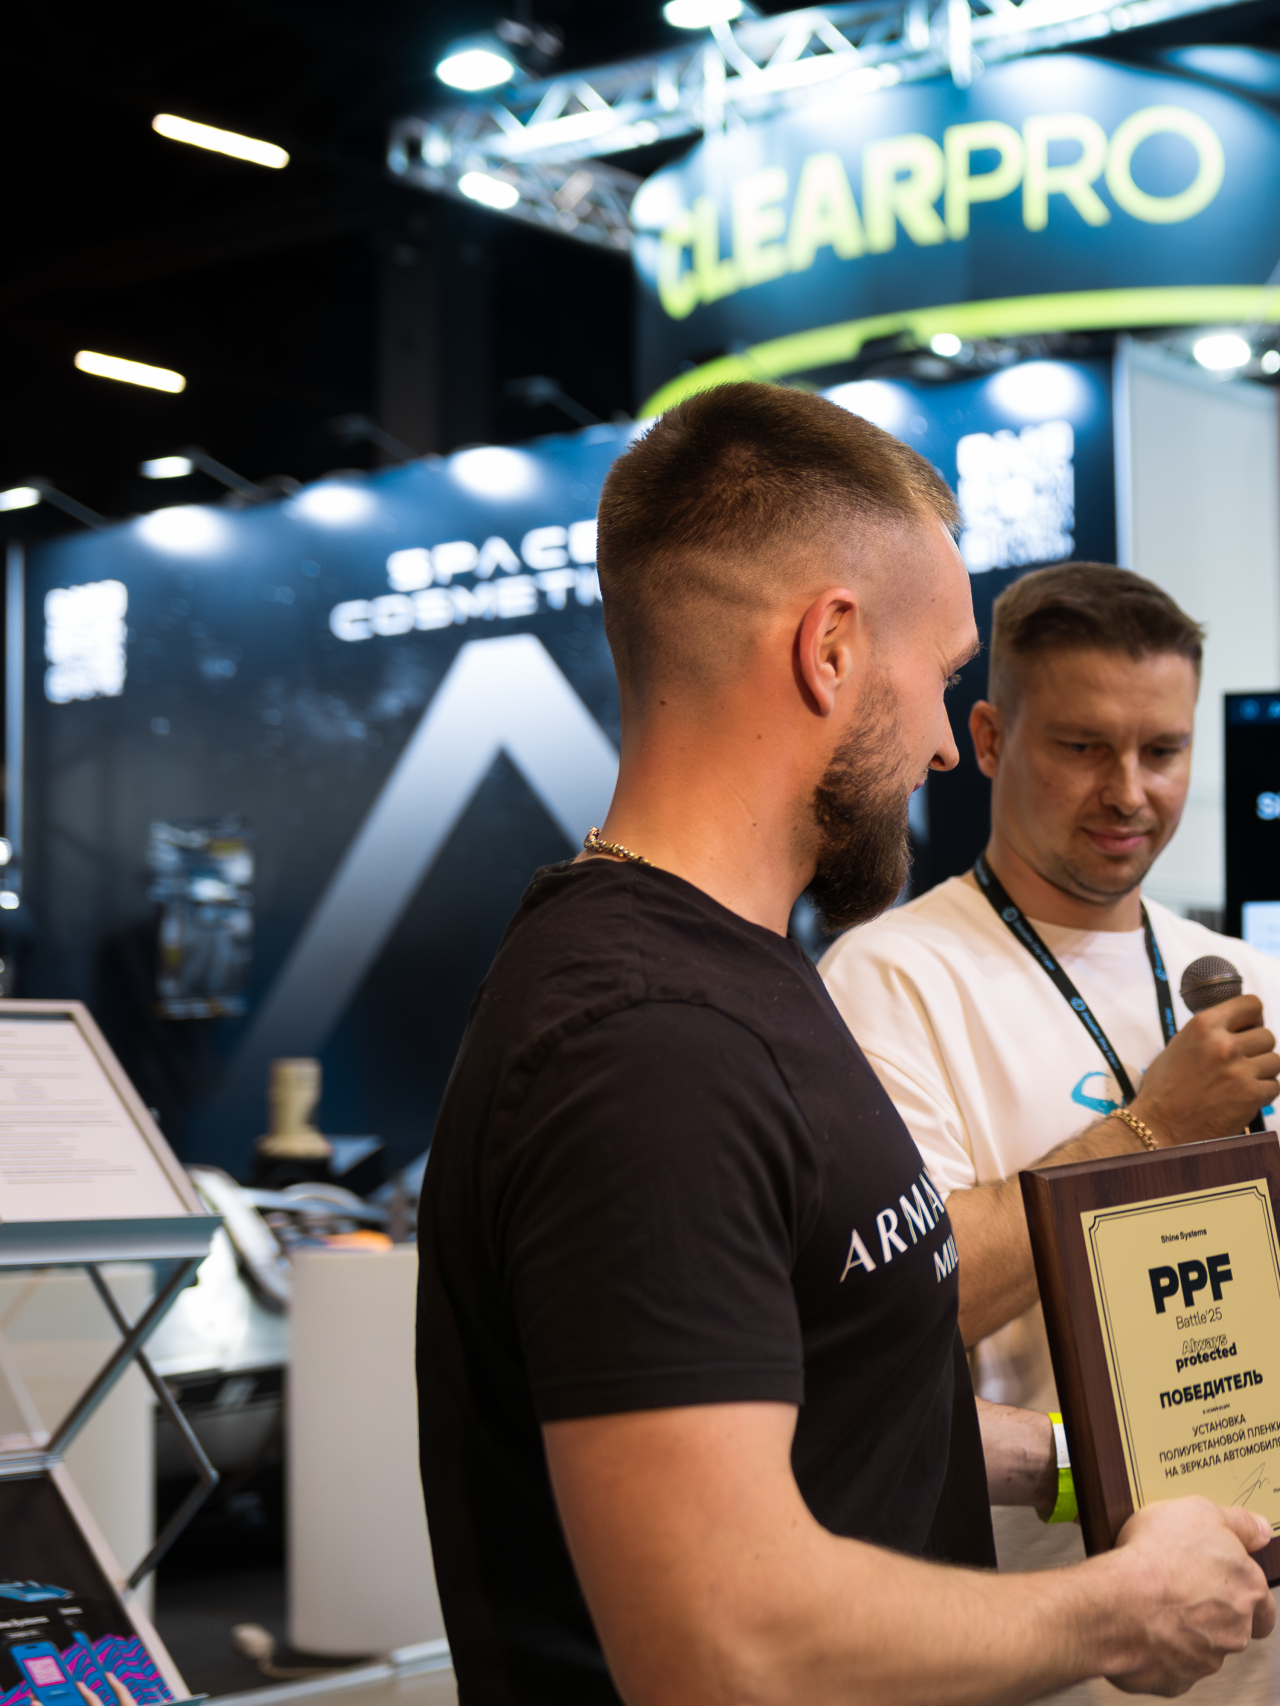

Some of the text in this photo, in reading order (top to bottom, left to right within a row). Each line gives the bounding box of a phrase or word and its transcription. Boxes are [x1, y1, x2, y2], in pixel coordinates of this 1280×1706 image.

[655, 104, 1226, 320] CLEARPRO
[329, 565, 603, 641] COSMETI
[839, 1166, 946, 1283] ARMA
[1160, 1228, 1207, 1244] Shine Systems
[1148, 1252, 1233, 1315] PPF
[1175, 1341, 1238, 1374] protected
[1181, 1333, 1228, 1356] Always
[1159, 1369, 1264, 1409] ПОБЕДИТЕЛЬ
[1191, 1413, 1247, 1437] УСТАНОВКА
[1159, 1428, 1246, 1463] ПОЛИУРЕТАНОВОЙ
[1164, 1466, 1179, 1480] НА
[1179, 1454, 1222, 1475] ЗЕРКАЛА
